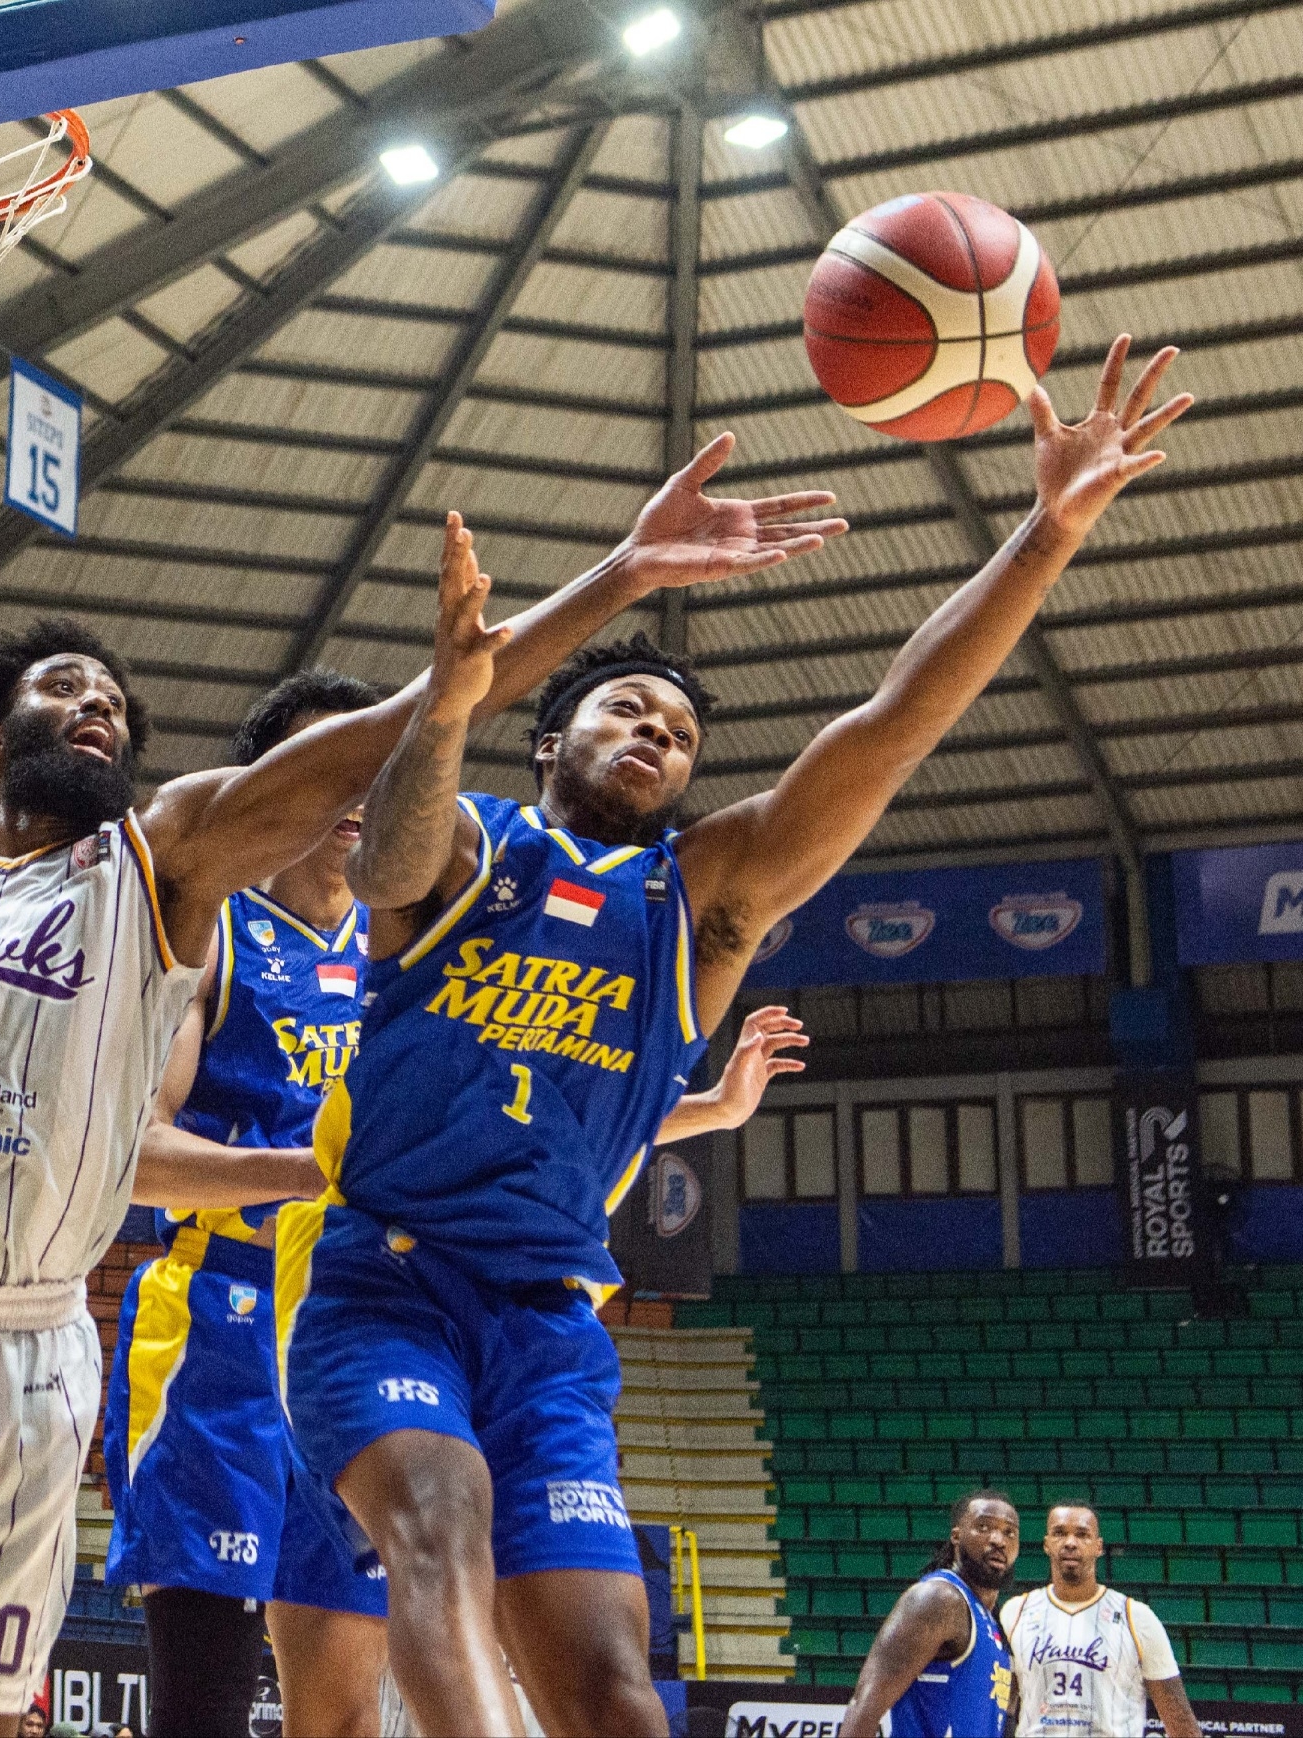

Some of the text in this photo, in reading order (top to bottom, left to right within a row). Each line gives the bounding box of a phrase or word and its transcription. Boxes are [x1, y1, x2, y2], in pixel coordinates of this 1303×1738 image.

[28, 445, 60, 513] 15
[261, 971, 291, 983] KELME
[442, 938, 636, 1011] SATRIA
[424, 977, 599, 1038] MUDA
[477, 1023, 636, 1073] PERTAMINA
[501, 1063, 533, 1125] 1
[1146, 1163, 1170, 1258] ROYAL
[1166, 1143, 1194, 1259] SPORTS
[549, 1488, 614, 1510] ROYAL
[550, 1506, 627, 1529] SPORTS
[1028, 1632, 1109, 1671] Hawks
[1053, 1672, 1083, 1697] 34
[1230, 1721, 1285, 1734] PARTNER
